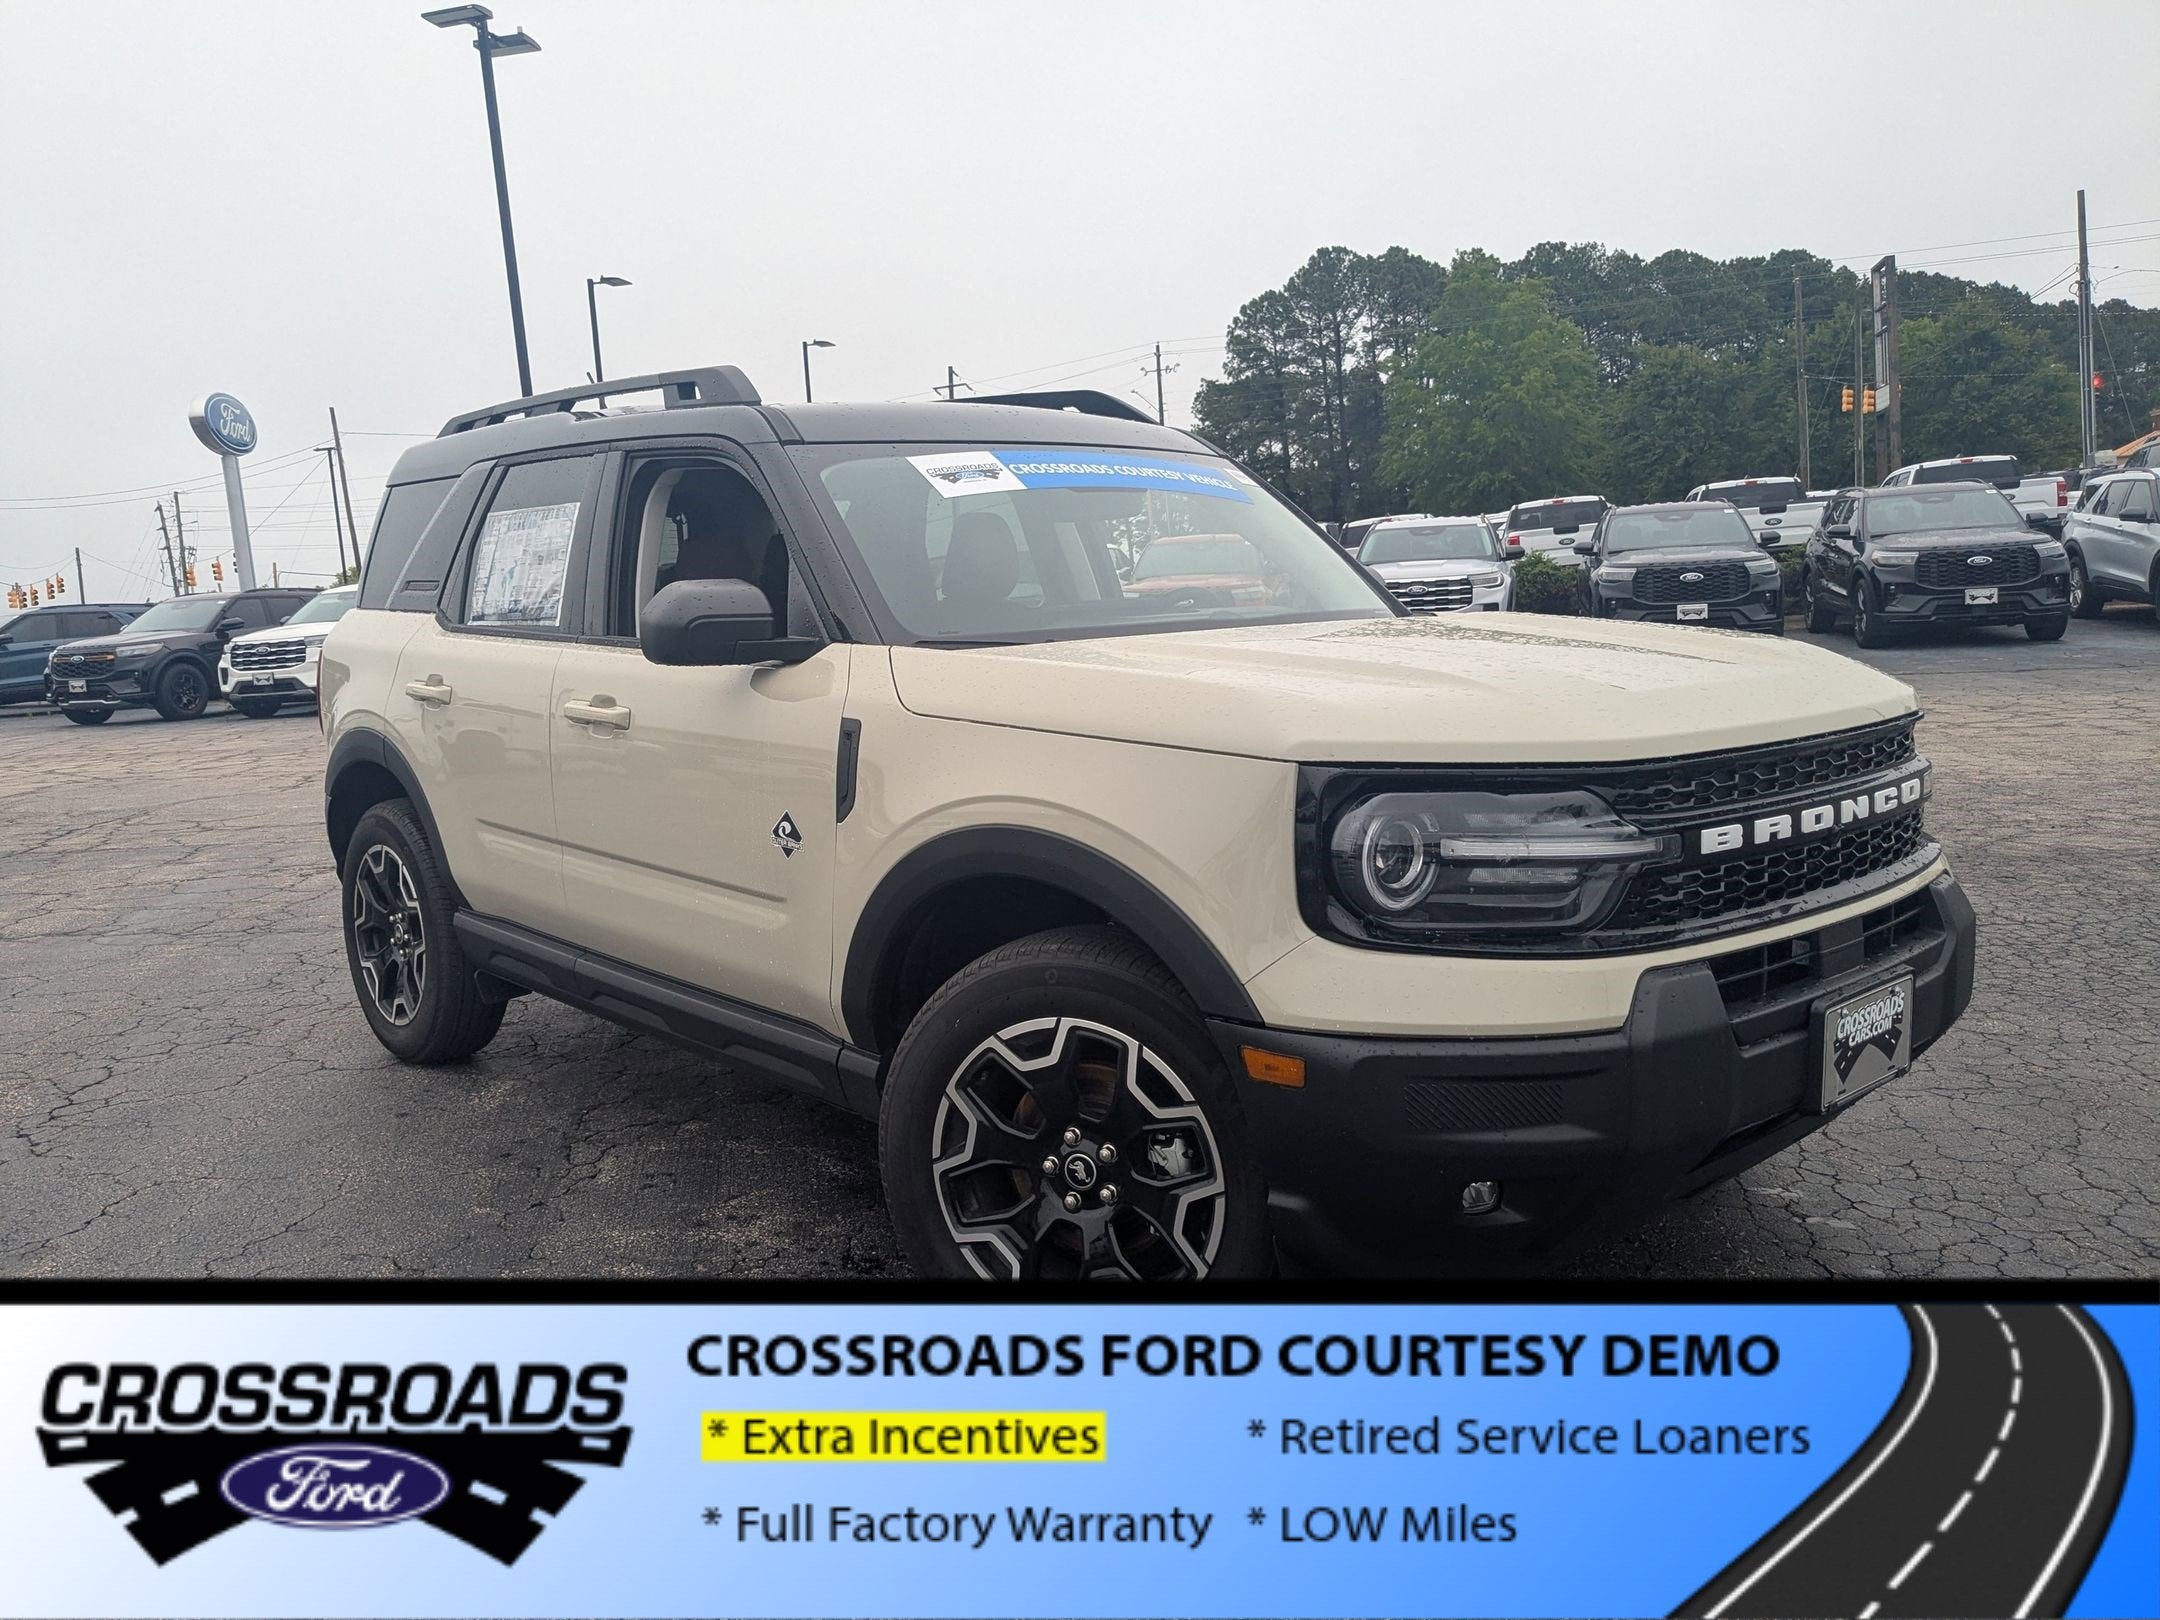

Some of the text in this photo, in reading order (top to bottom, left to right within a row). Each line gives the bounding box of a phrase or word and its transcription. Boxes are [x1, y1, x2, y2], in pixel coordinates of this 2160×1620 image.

[221, 403, 250, 442] Ford
[926, 463, 998, 475] CROSSROADS
[1008, 463, 1113, 475] CROSSROADS
[1114, 465, 1185, 481] COURTESY
[1701, 778, 1921, 855] BRONCO
[1837, 993, 1904, 1039] CROSSROADS
[1849, 1016, 1892, 1046] CARS.COM
